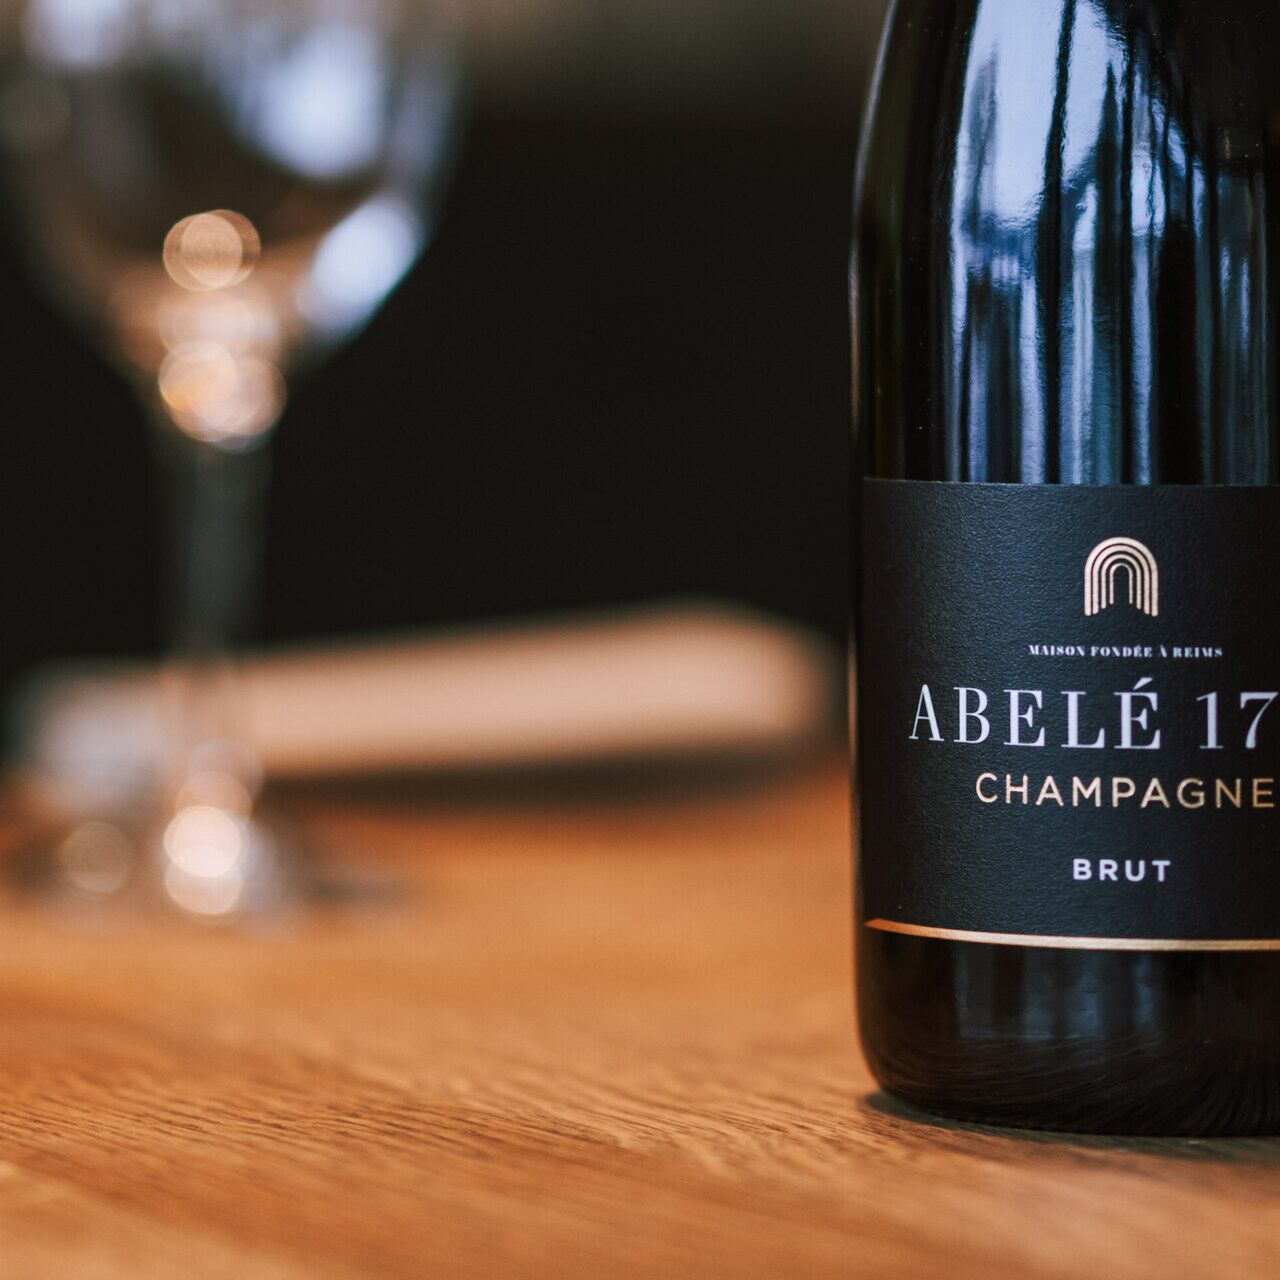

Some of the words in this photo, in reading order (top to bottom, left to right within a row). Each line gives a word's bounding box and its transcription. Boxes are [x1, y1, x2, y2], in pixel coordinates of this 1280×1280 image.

[1028, 644, 1086, 657] MAISON
[1091, 643, 1154, 658] FONDÉE
[1172, 646, 1224, 658] REIMS
[908, 677, 1162, 750] ABELÉ
[975, 772, 1275, 809] CHAMPAGNE
[1072, 858, 1171, 883] BRUT
